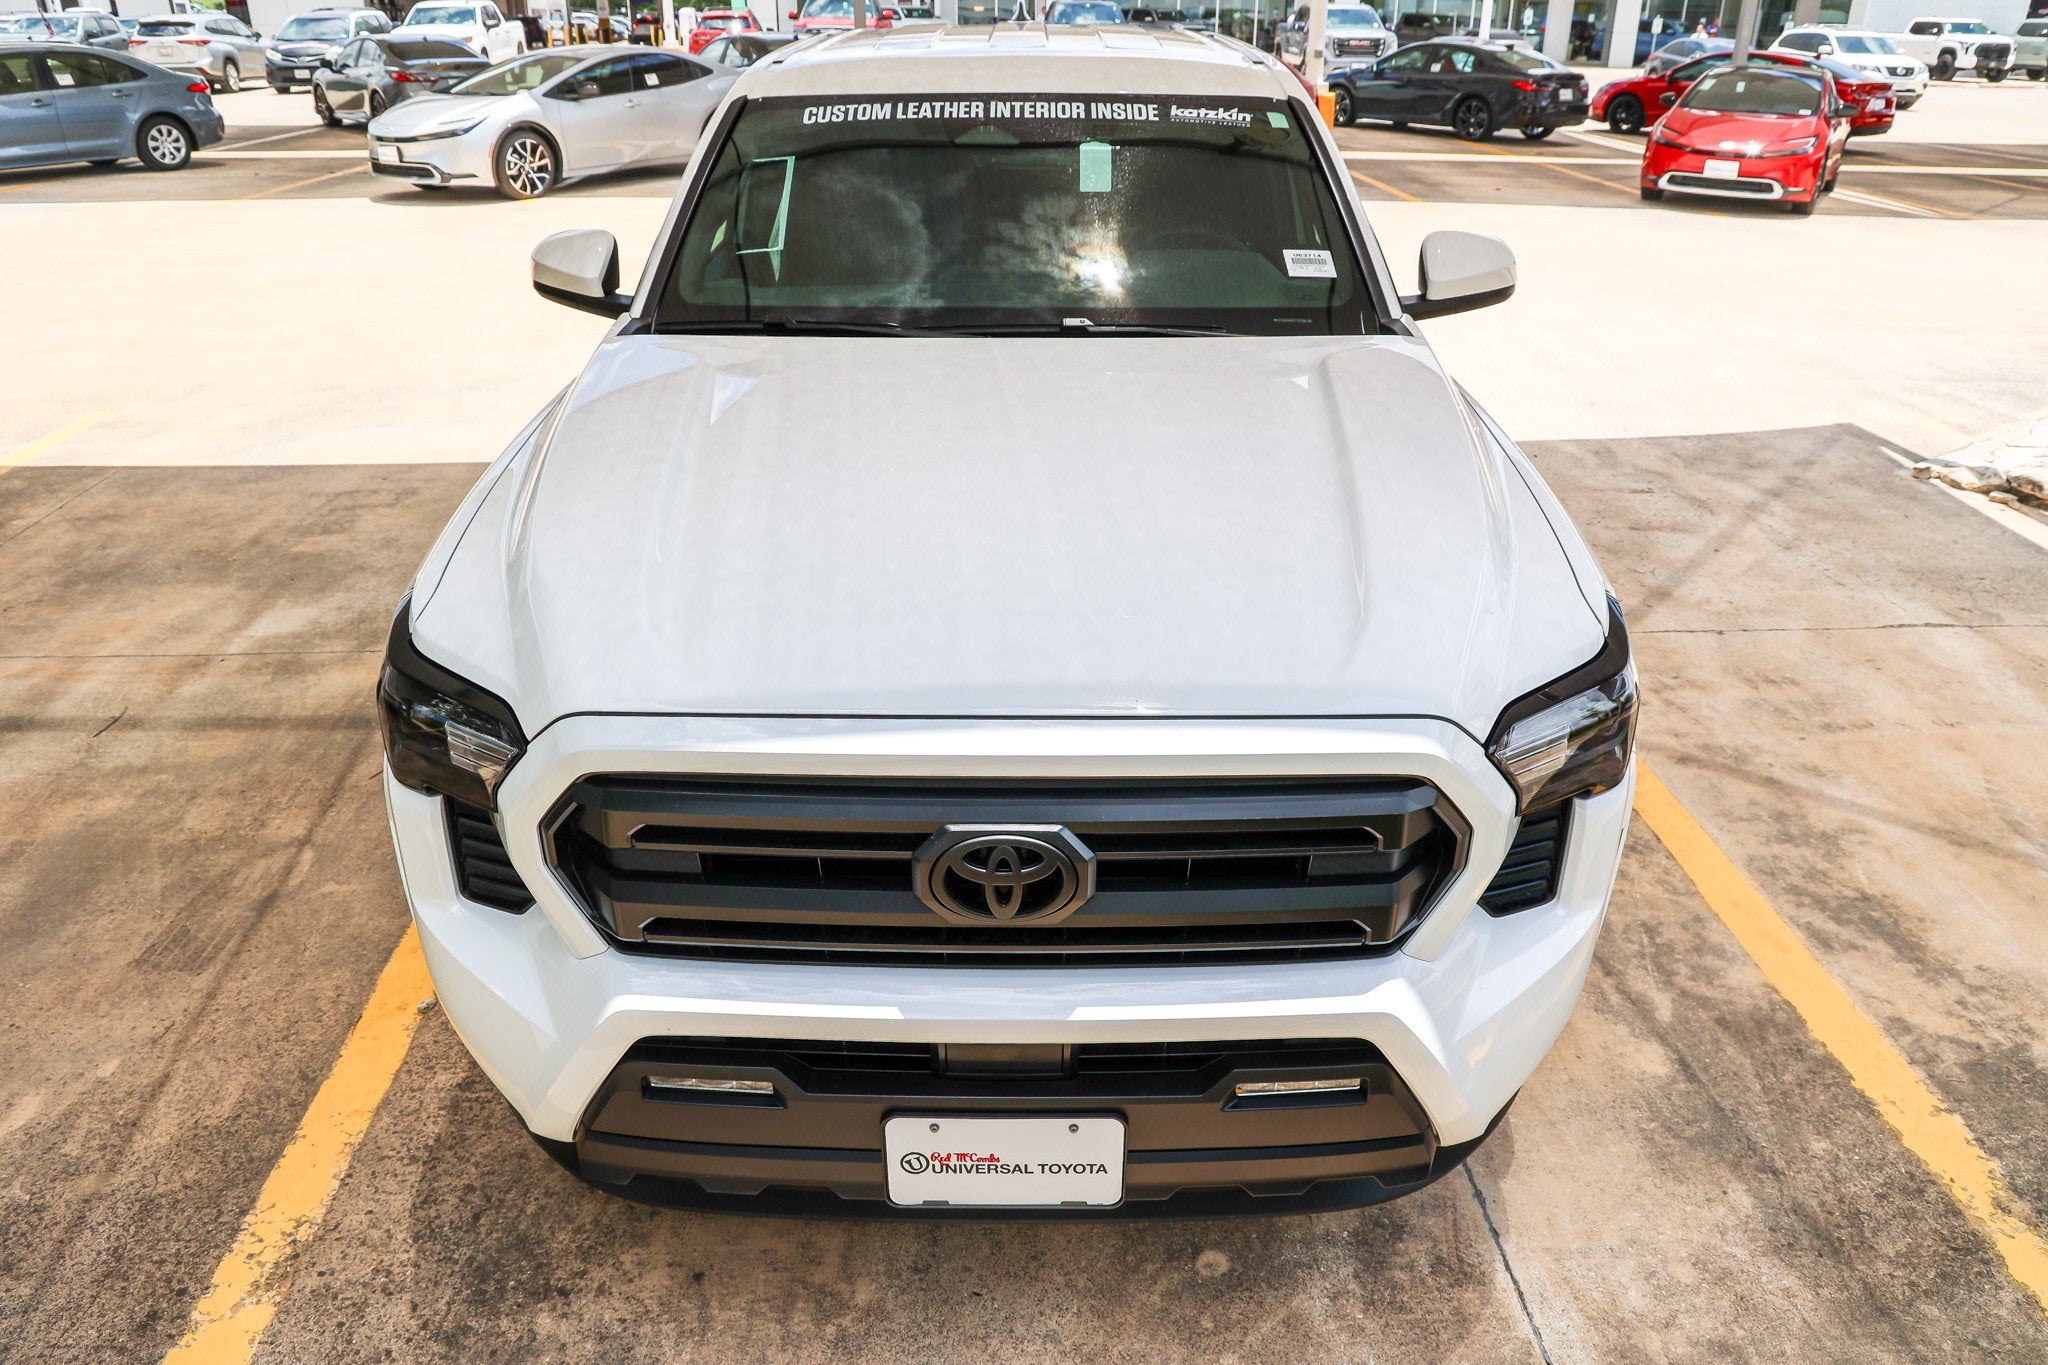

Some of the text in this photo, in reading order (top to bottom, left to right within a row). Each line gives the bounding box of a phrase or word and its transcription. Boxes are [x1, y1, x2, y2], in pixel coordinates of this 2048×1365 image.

[802, 101, 1160, 125] CUSTOM LEATHER INTERIOR INSIDE
[1170, 104, 1251, 122] katzkin
[930, 1151, 1001, 1166] Red McCombs
[931, 1163, 1108, 1174] UNIVERSAL TOYOTA
